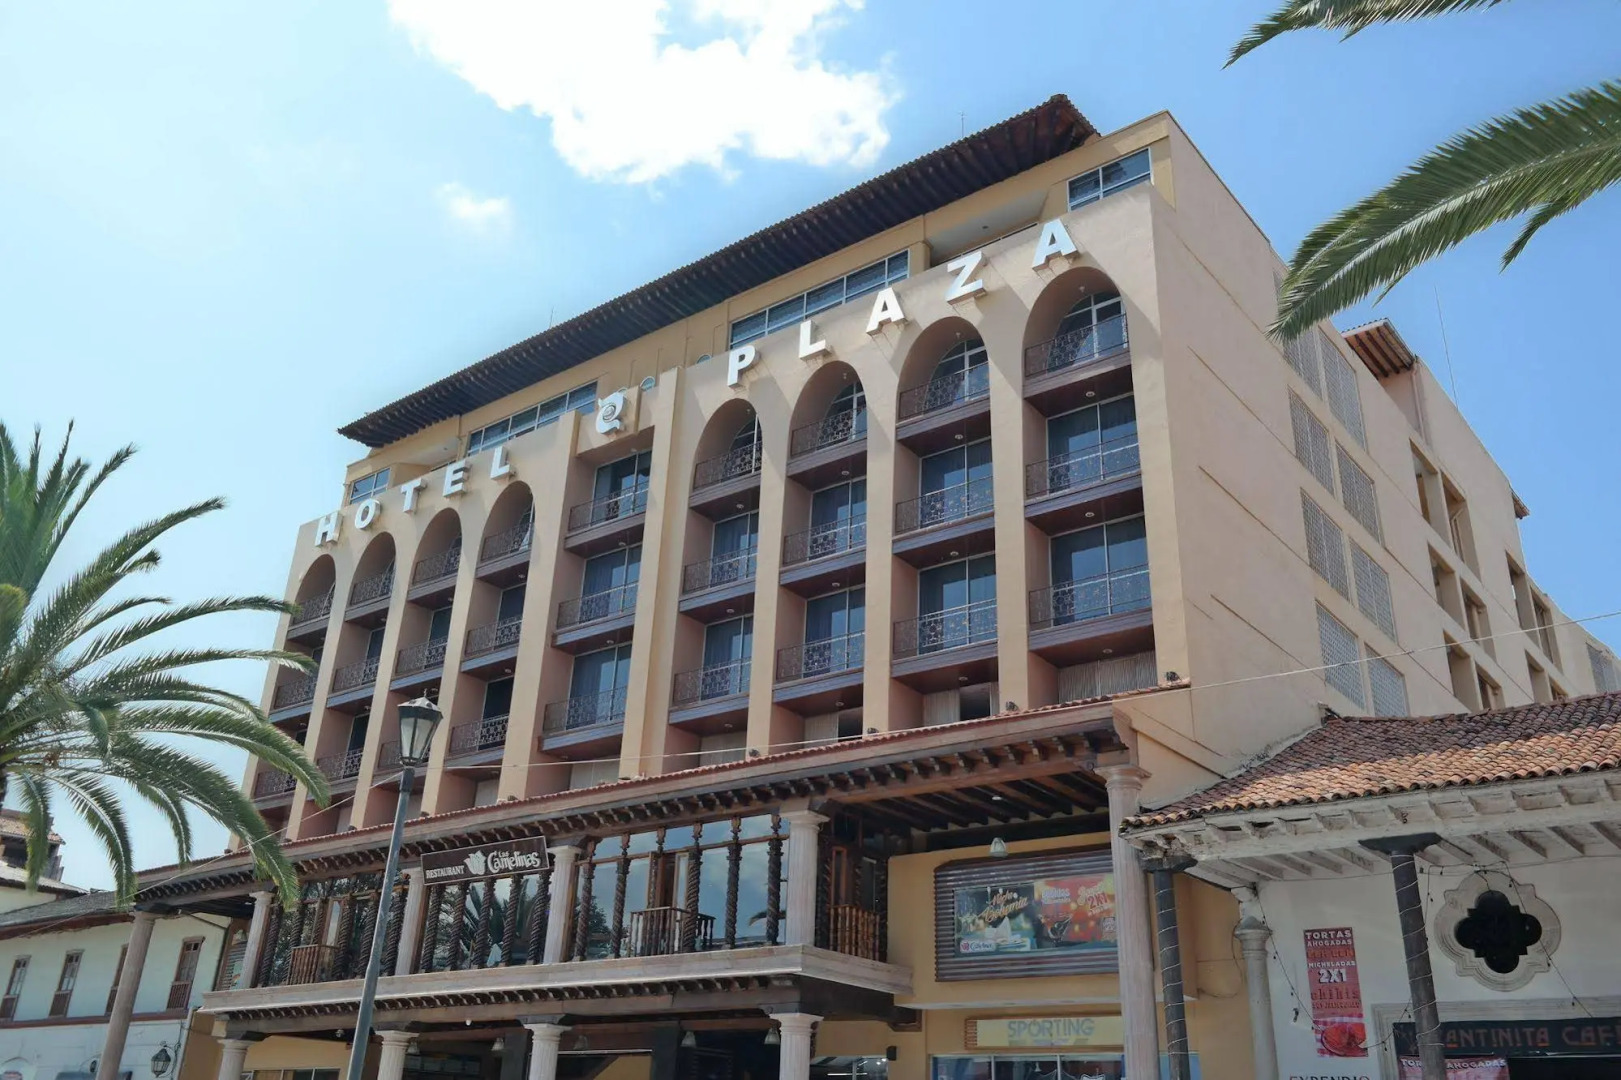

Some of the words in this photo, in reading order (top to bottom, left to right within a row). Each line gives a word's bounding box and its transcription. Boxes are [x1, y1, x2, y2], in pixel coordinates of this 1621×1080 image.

[314, 445, 516, 547] HOTEL
[727, 218, 1078, 388] PLAZA
[487, 850, 541, 873] Camelinas
[425, 865, 465, 879] RESTAURANT
[1305, 929, 1352, 940] TORTAS
[1307, 939, 1352, 947] AHOGADAS
[1308, 960, 1356, 968] MICHELADAS
[1319, 968, 1347, 983] 2X1
[1008, 1018, 1095, 1037] SPORTING
[1445, 1027, 1550, 1048] ANTINITA
[1446, 1058, 1506, 1069] AHOGADAS
